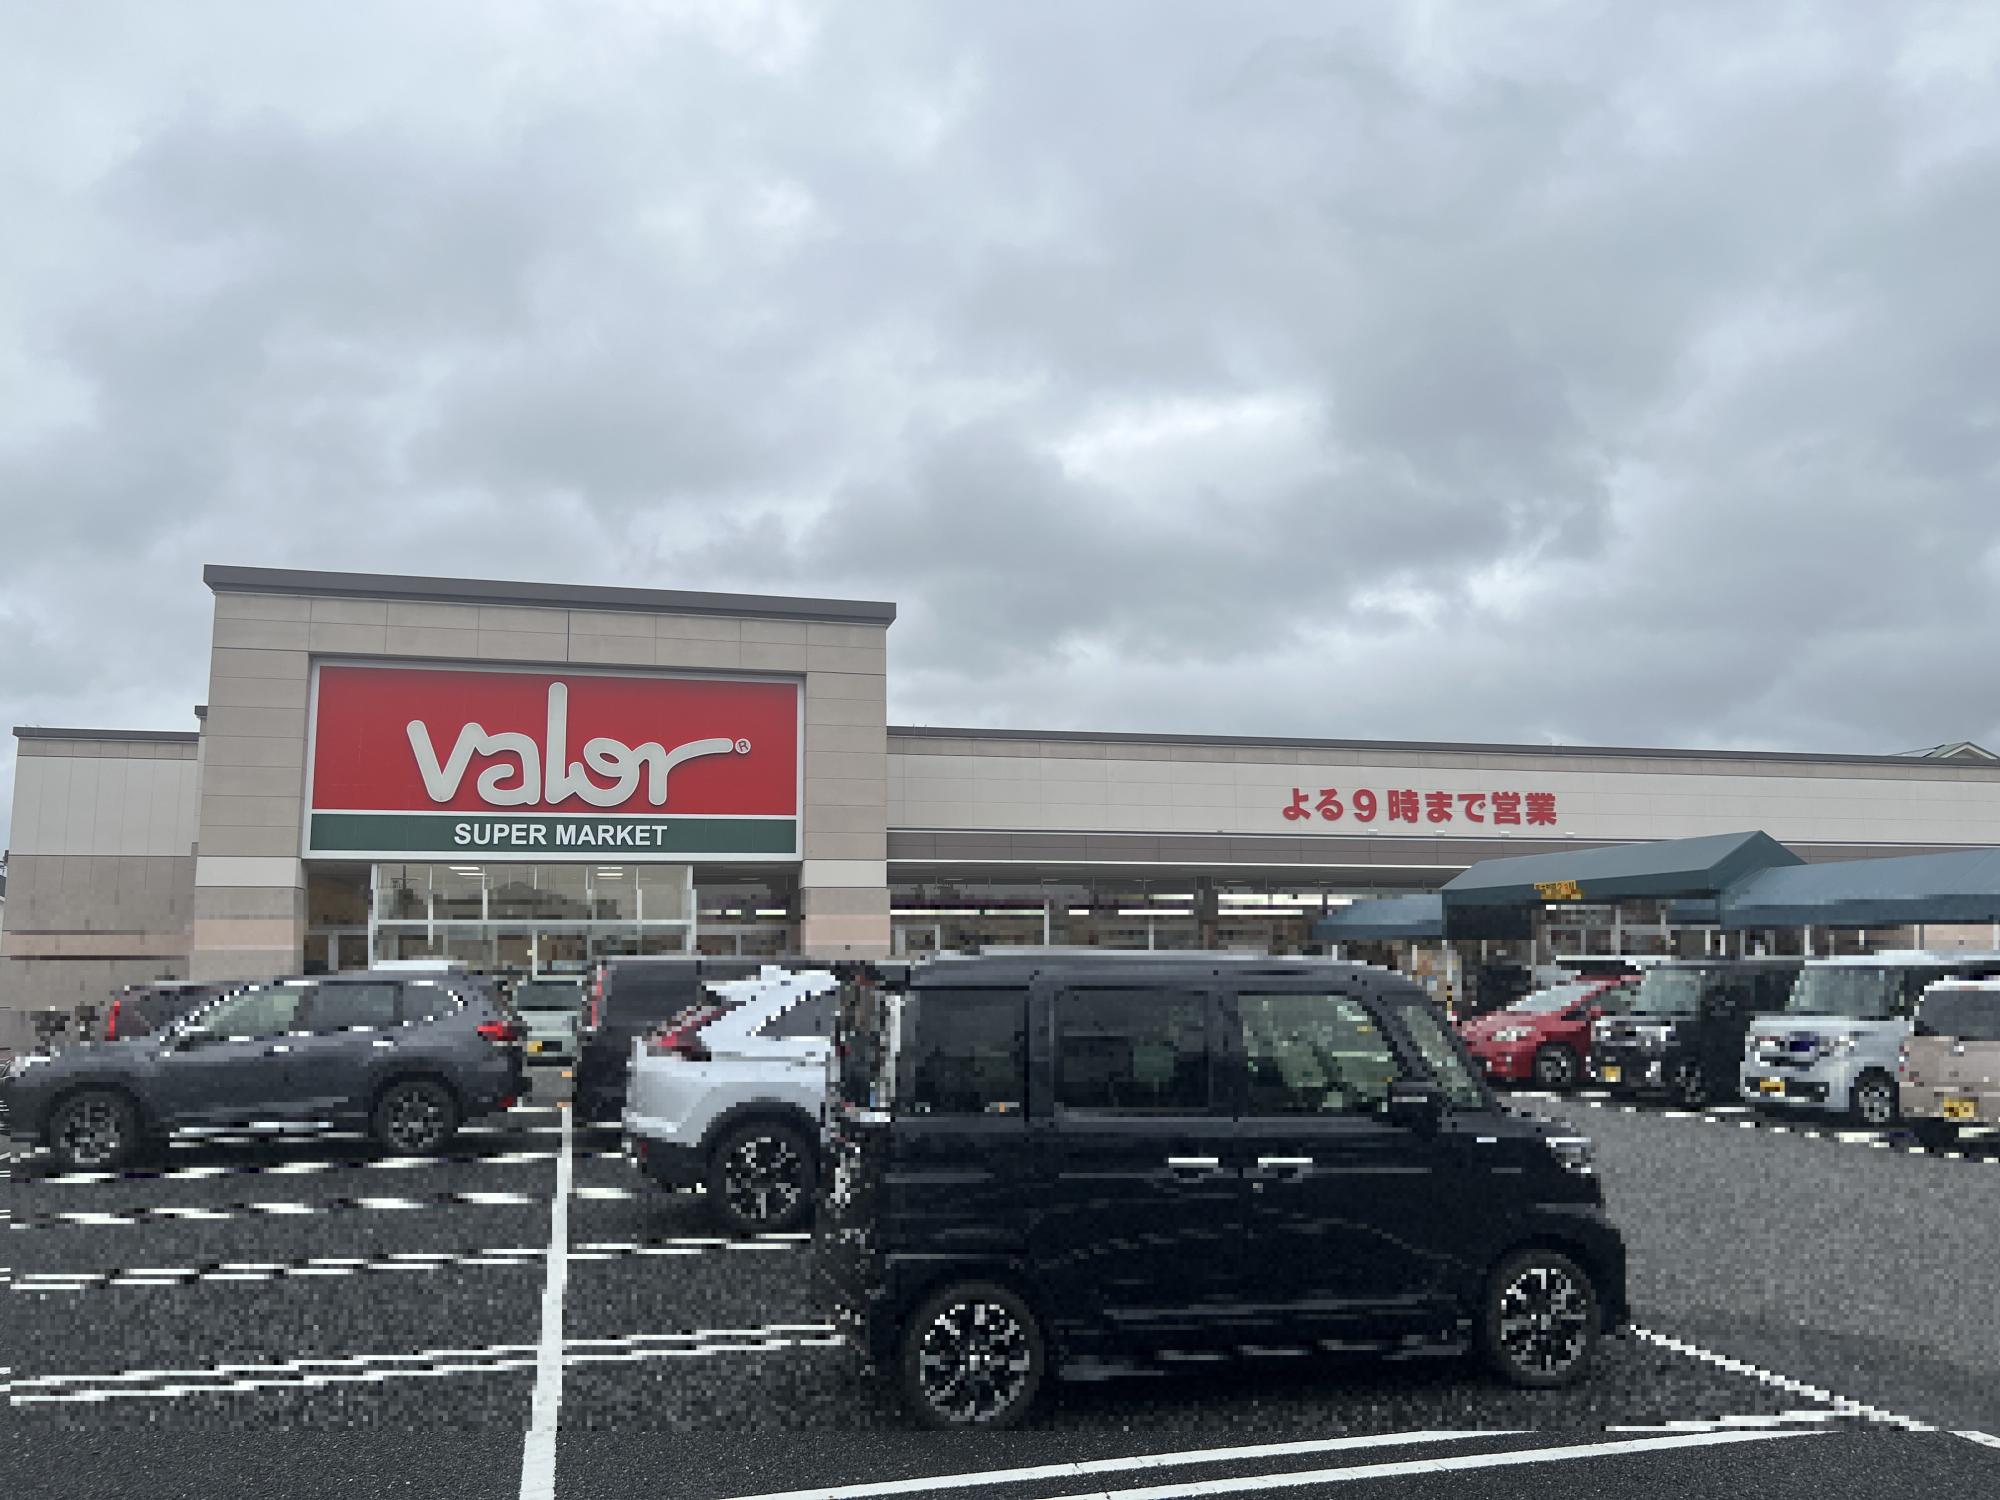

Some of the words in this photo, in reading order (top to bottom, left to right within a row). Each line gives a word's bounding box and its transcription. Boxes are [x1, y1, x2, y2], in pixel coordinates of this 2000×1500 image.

[1282, 788, 1558, 826] よる9時まで営業
[454, 823, 547, 846] SUPER
[555, 824, 668, 847] MARKET
